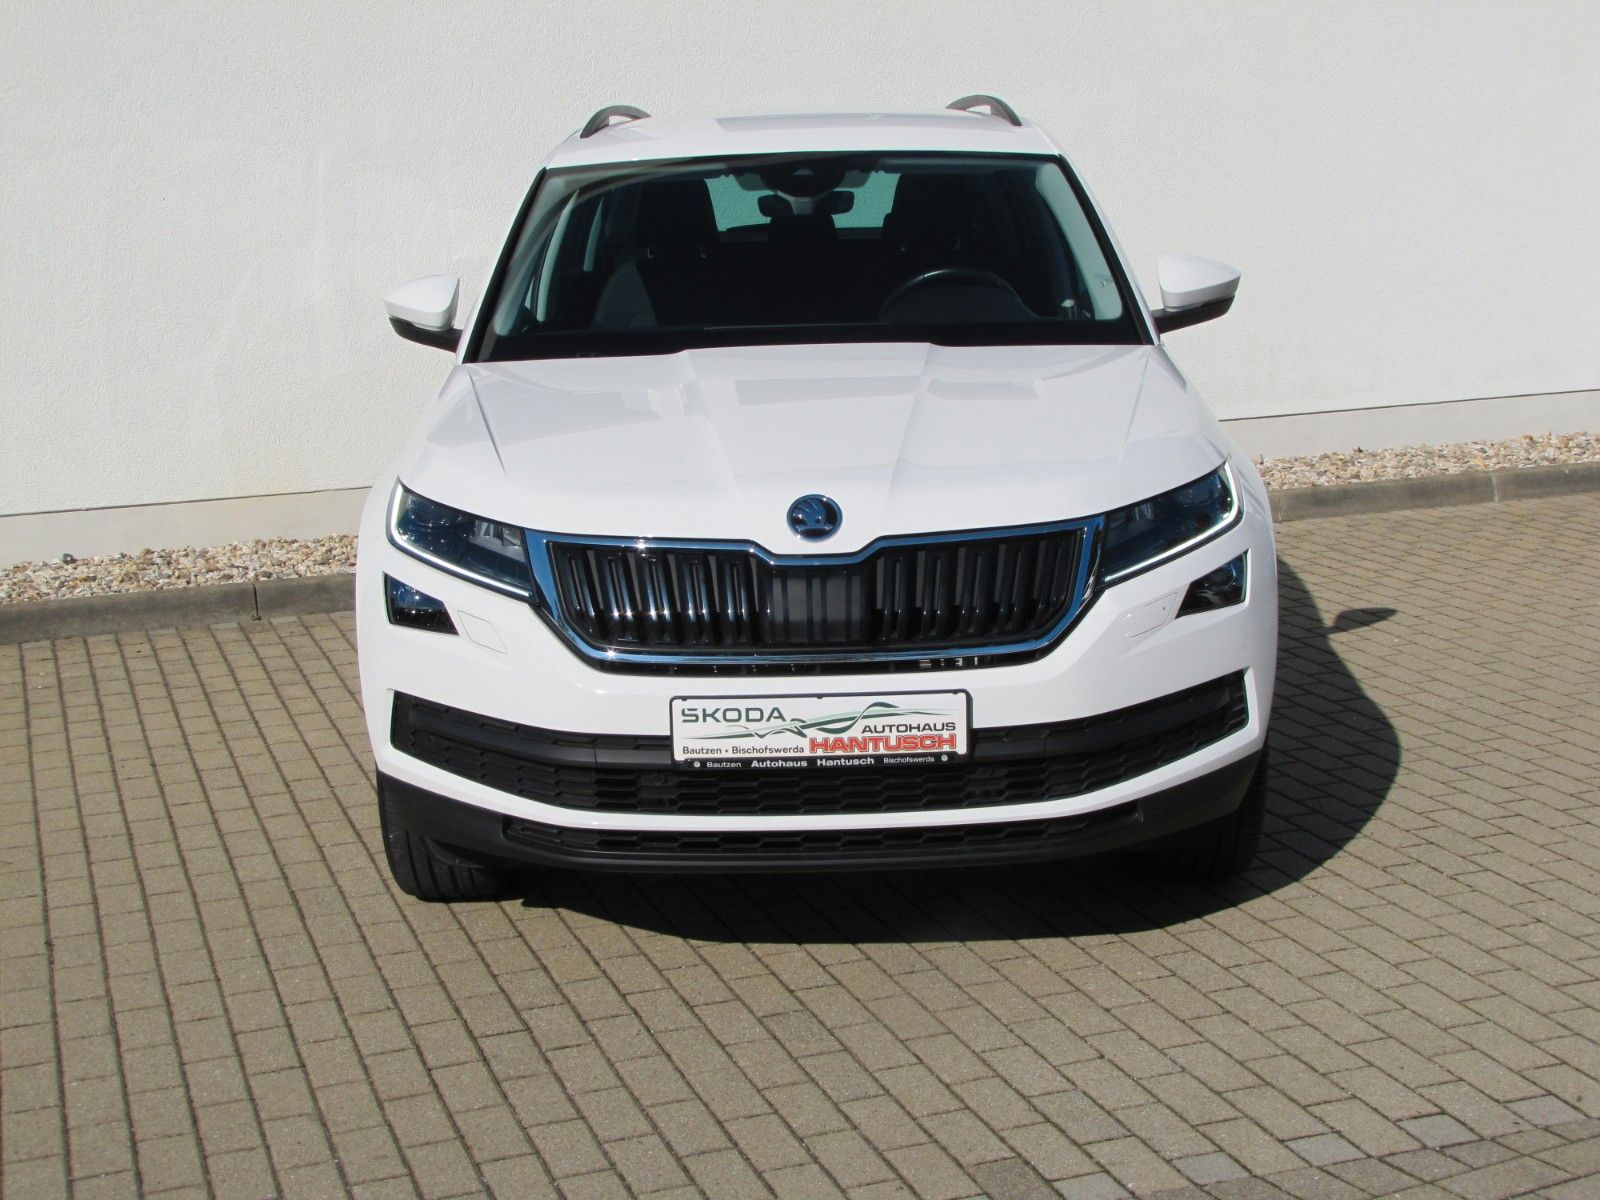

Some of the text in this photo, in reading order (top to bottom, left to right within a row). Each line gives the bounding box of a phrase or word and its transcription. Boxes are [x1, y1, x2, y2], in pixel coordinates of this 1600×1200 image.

[862, 722, 956, 734] AUTOHAUS
[809, 733, 957, 754] HANTUSCH
[682, 745, 805, 755] Bautzen Bischofswerda
[750, 760, 808, 768] Autohaus
[816, 757, 875, 767] Hantusch
[883, 756, 935, 764] Bischofswerda
